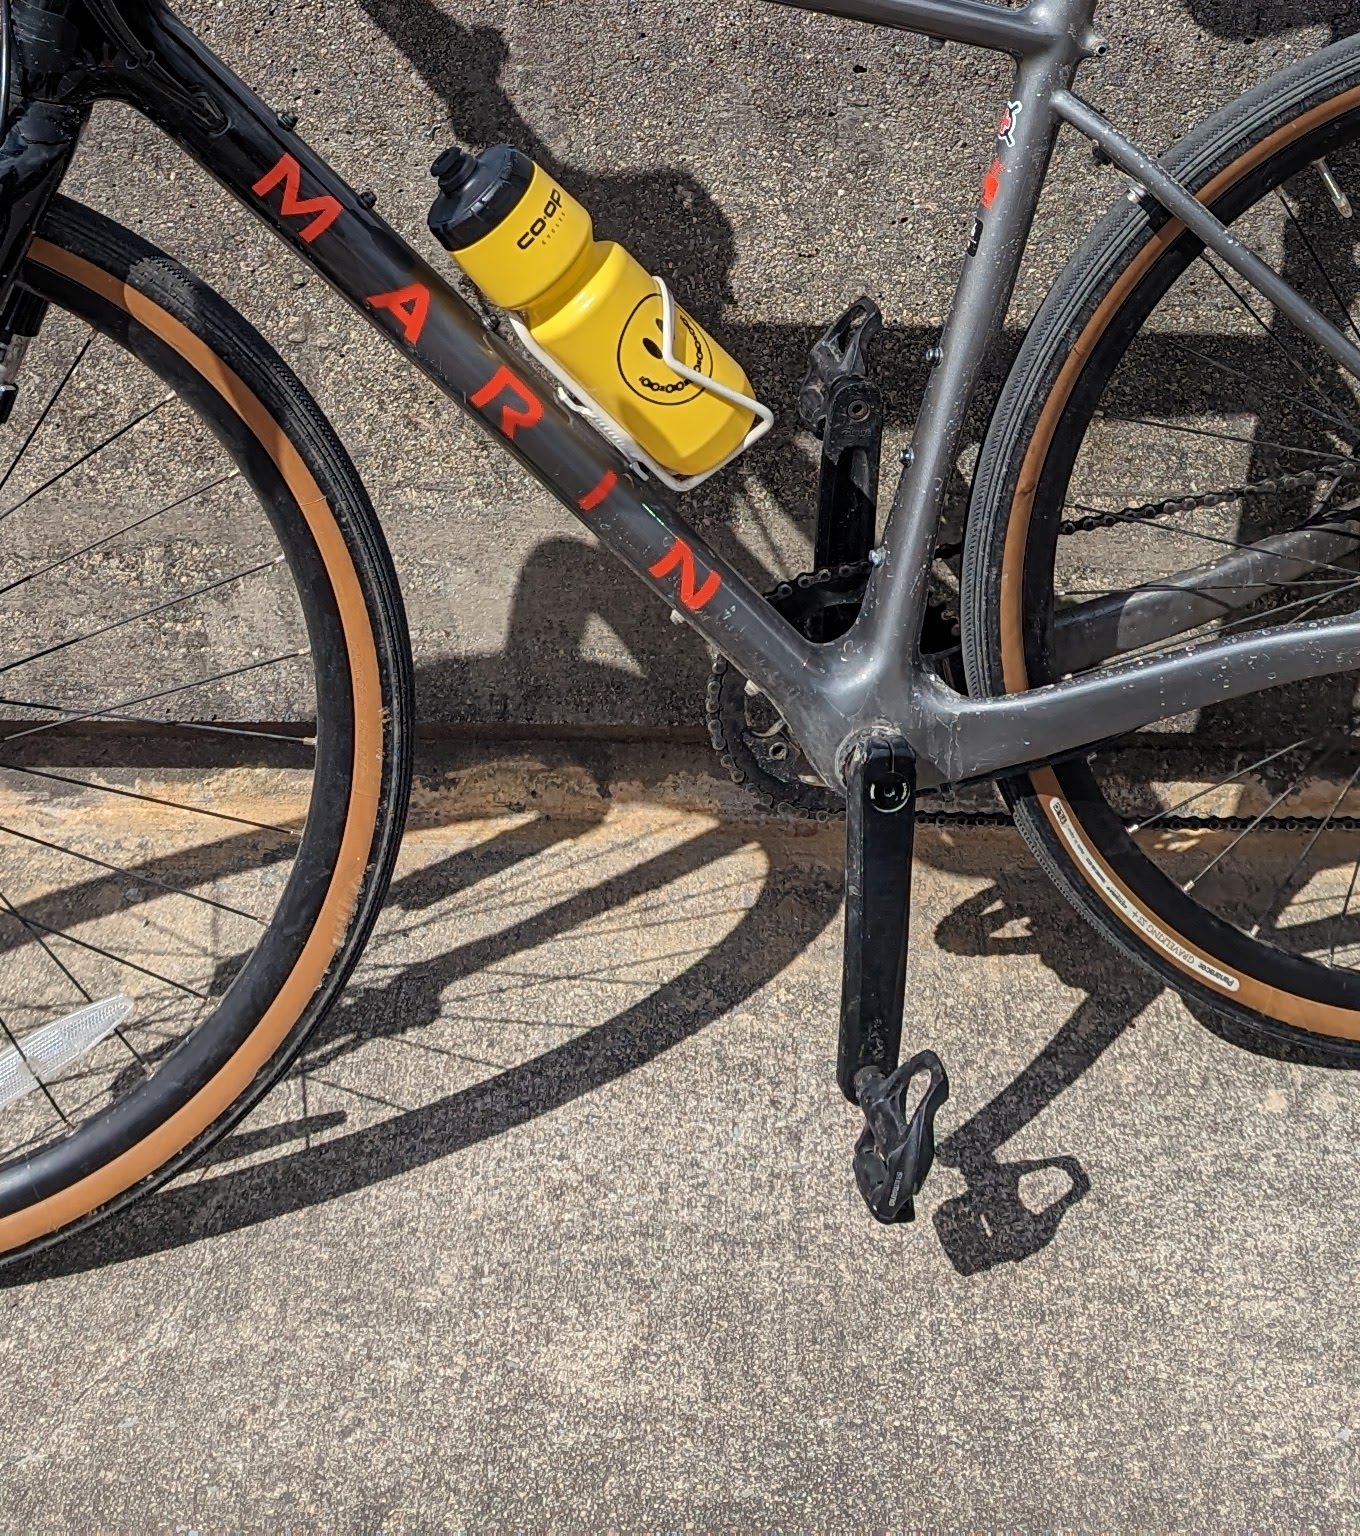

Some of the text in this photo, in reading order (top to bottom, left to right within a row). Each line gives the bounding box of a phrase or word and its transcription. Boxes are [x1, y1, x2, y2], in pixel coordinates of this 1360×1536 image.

[252, 153, 722, 611] MARIN
[1145, 923, 1195, 965] GRAVELKING
[1197, 961, 1235, 987] Panaracer
